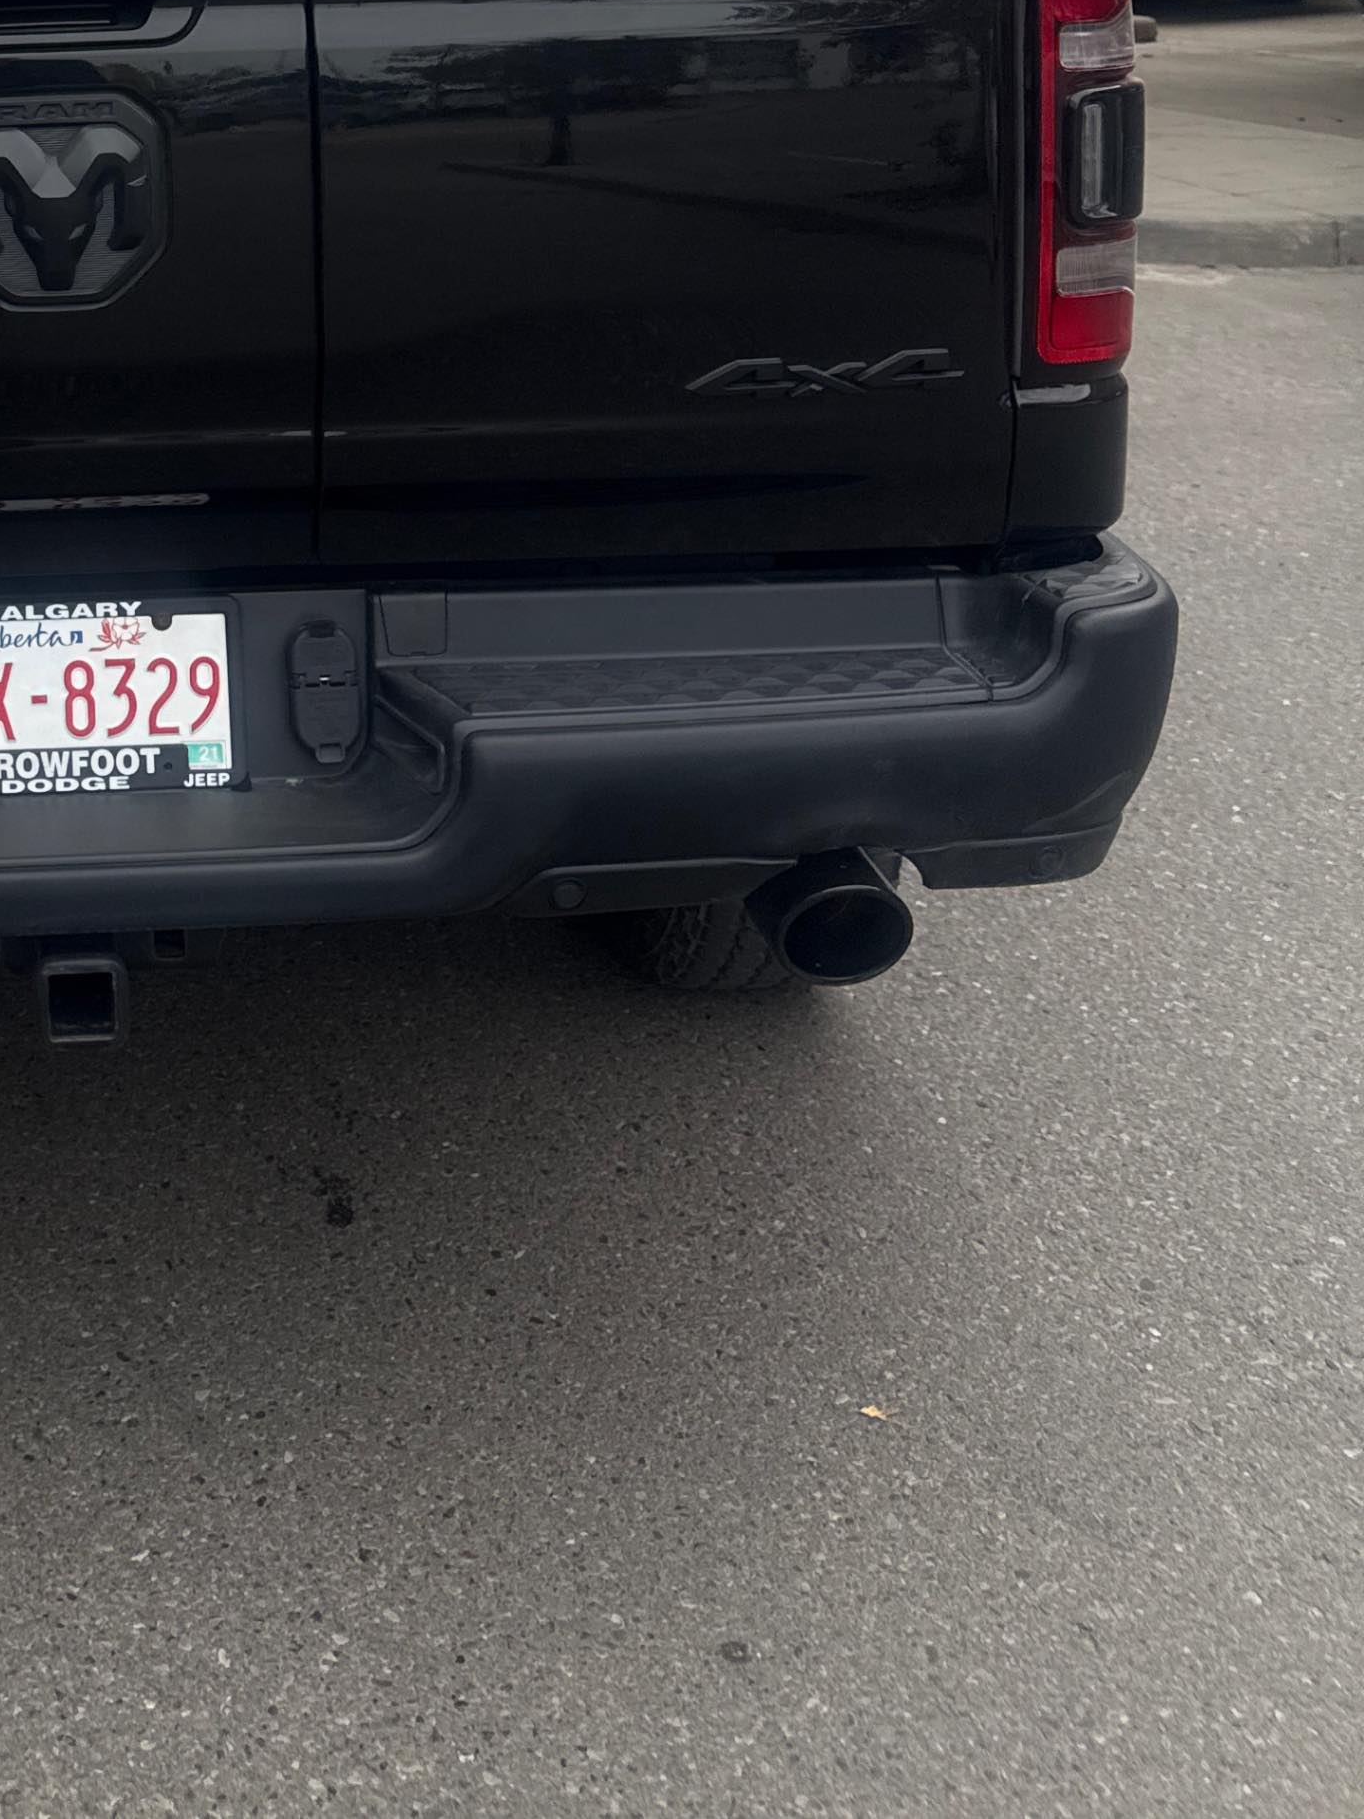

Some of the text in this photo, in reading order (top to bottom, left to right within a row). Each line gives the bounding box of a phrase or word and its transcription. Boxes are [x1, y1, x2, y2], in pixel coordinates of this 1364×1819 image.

[199, 745, 218, 761] 21
[1, 776, 130, 794] DODGE
[183, 772, 231, 788] JEEP
